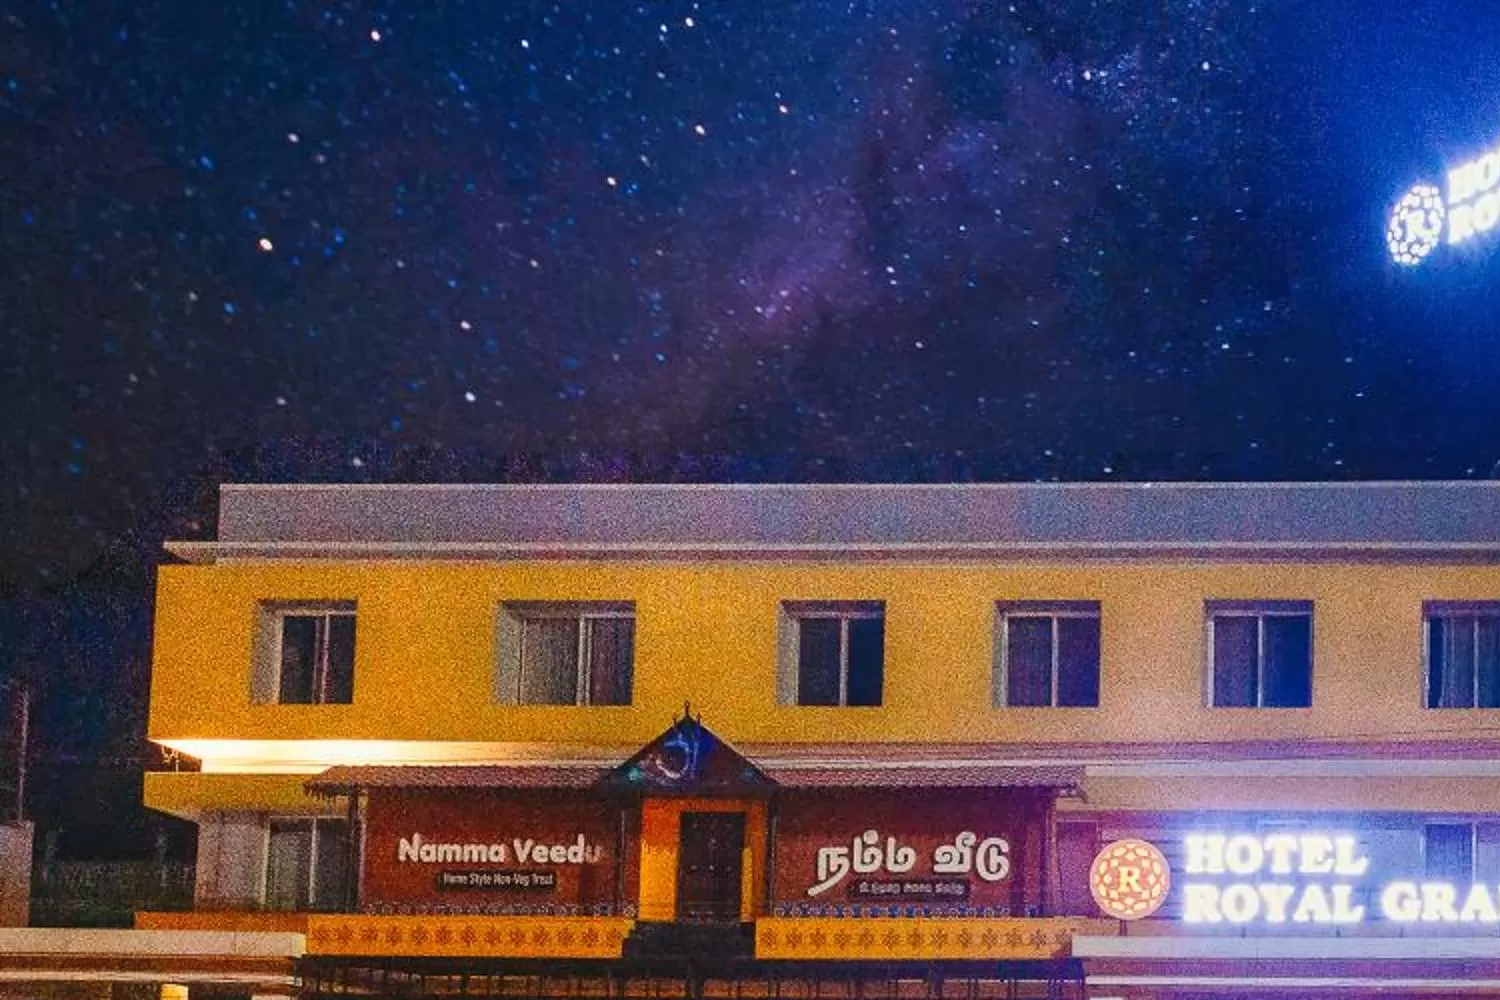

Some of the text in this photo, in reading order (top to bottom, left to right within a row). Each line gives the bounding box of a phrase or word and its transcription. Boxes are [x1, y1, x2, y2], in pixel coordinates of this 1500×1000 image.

[398, 832, 601, 864] Namma Veedu
[807, 829, 1009, 896] நம்ம வீடு
[1184, 834, 1368, 876] HOTEL
[1118, 867, 1141, 892] R
[1183, 884, 1363, 923] ROYAL
